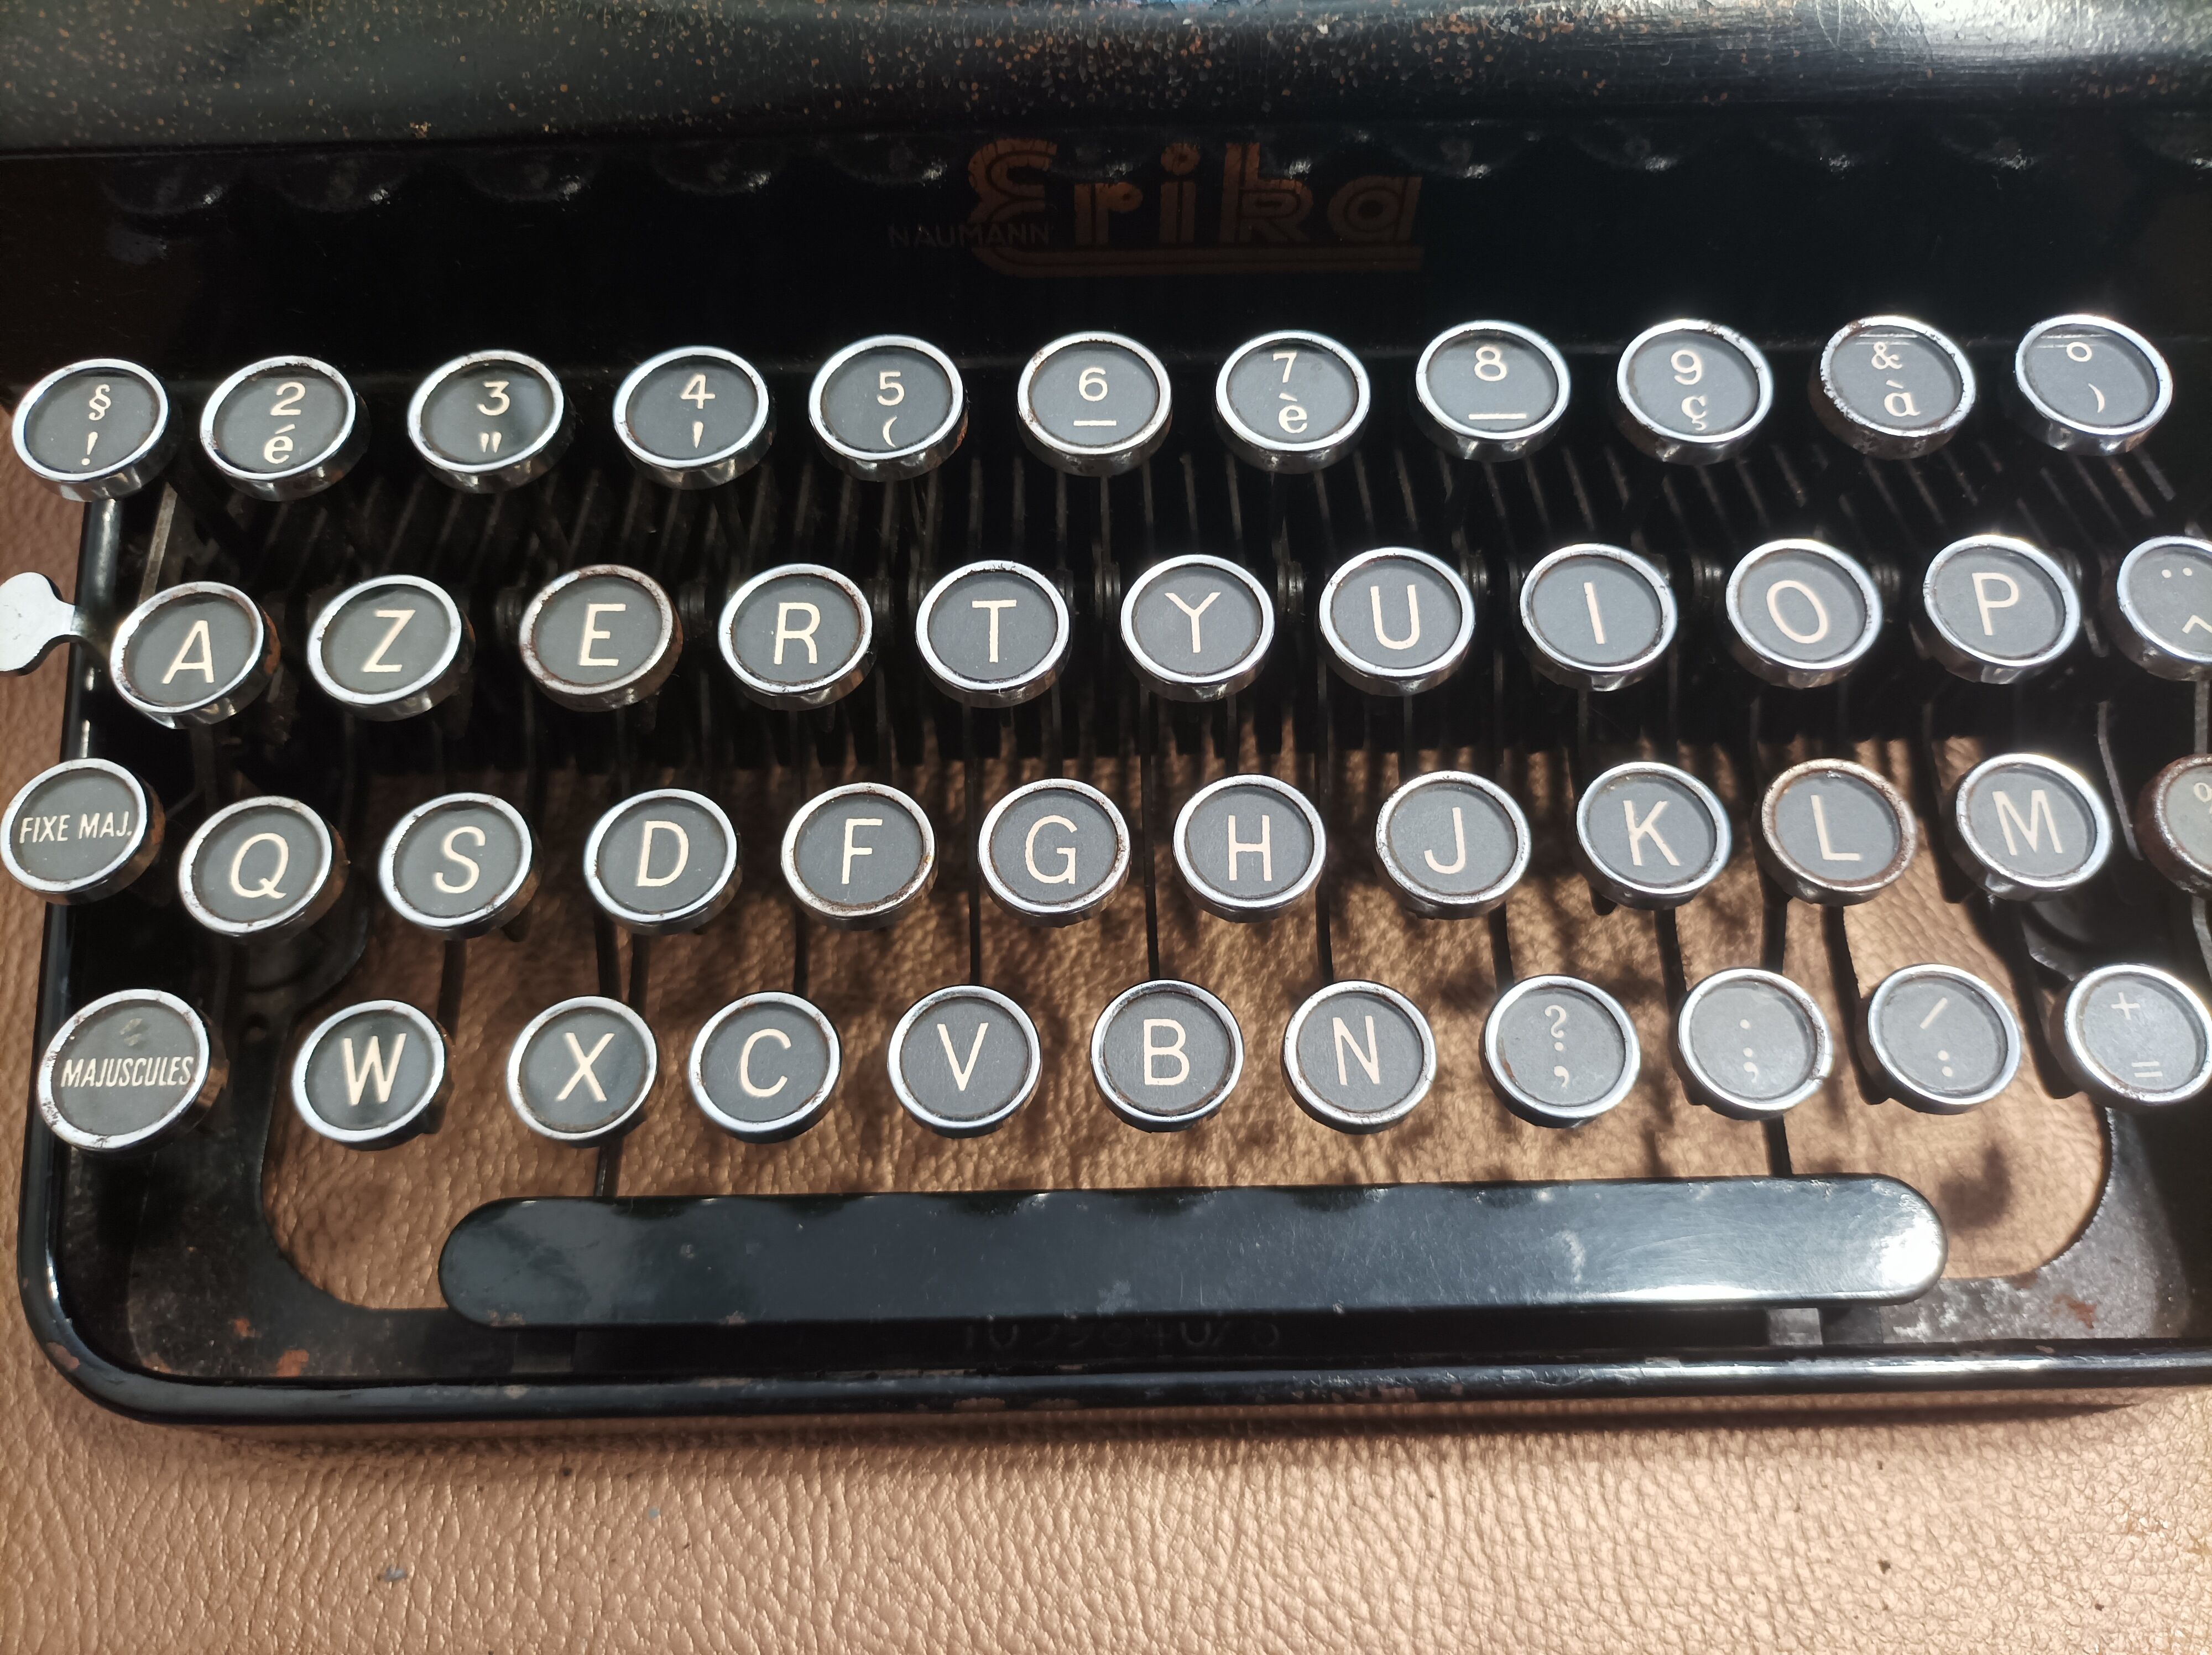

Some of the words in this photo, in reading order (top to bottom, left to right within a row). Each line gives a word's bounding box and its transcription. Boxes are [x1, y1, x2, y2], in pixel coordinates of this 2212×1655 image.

[888, 223, 1051, 248] NAUMANN
[968, 138, 1423, 277] Erika
[1078, 367, 1108, 402] 6
[1273, 352, 1297, 383] 7
[1474, 346, 1507, 382] 8
[1671, 349, 1703, 385] 9
[1871, 341, 1904, 369] &
[88, 384, 111, 421] §
[270, 382, 306, 416] 2
[477, 381, 510, 416] 3
[680, 374, 716, 409] 4
[877, 371, 905, 406] 5
[1278, 393, 1308, 434] è
[1681, 395, 1707, 431] ç
[1884, 379, 1921, 417] à
[81, 431, 98, 466] !
[263, 423, 296, 464] é
[882, 417, 897, 447] (
[578, 603, 626, 667] E
[774, 602, 821, 665] R
[972, 599, 1017, 663] T
[1165, 592, 1221, 653] Y
[1370, 584, 1420, 650] U
[1584, 582, 1605, 644] I
[1766, 580, 1829, 644] O
[1972, 572, 2020, 636] P
[162, 620, 215, 684] A
[362, 610, 415, 673] Z
[20, 815, 69, 844] FIXE
[79, 811, 133, 839] MAJ.
[636, 820, 689, 887] D
[841, 818, 883, 884] F
[1025, 815, 1077, 884] G
[1228, 815, 1272, 881] H
[1424, 807, 1466, 875] J
[1623, 800, 1681, 866] K
[1811, 795, 1862, 861] L
[1992, 789, 2063, 856] M
[229, 832, 289, 899] Q
[434, 826, 486, 894] S
[1545, 1005, 1567, 1052] ?
[2111, 992, 2141, 1021] +
[61, 1057, 195, 1087] MAJUSCULES
[342, 1033, 406, 1106] W
[556, 1032, 614, 1101] X
[739, 1028, 791, 1098] C
[937, 1022, 989, 1091] V
[1143, 1018, 1190, 1086] B
[1332, 1016, 1380, 1086] N
[2131, 1060, 2163, 1078] =
